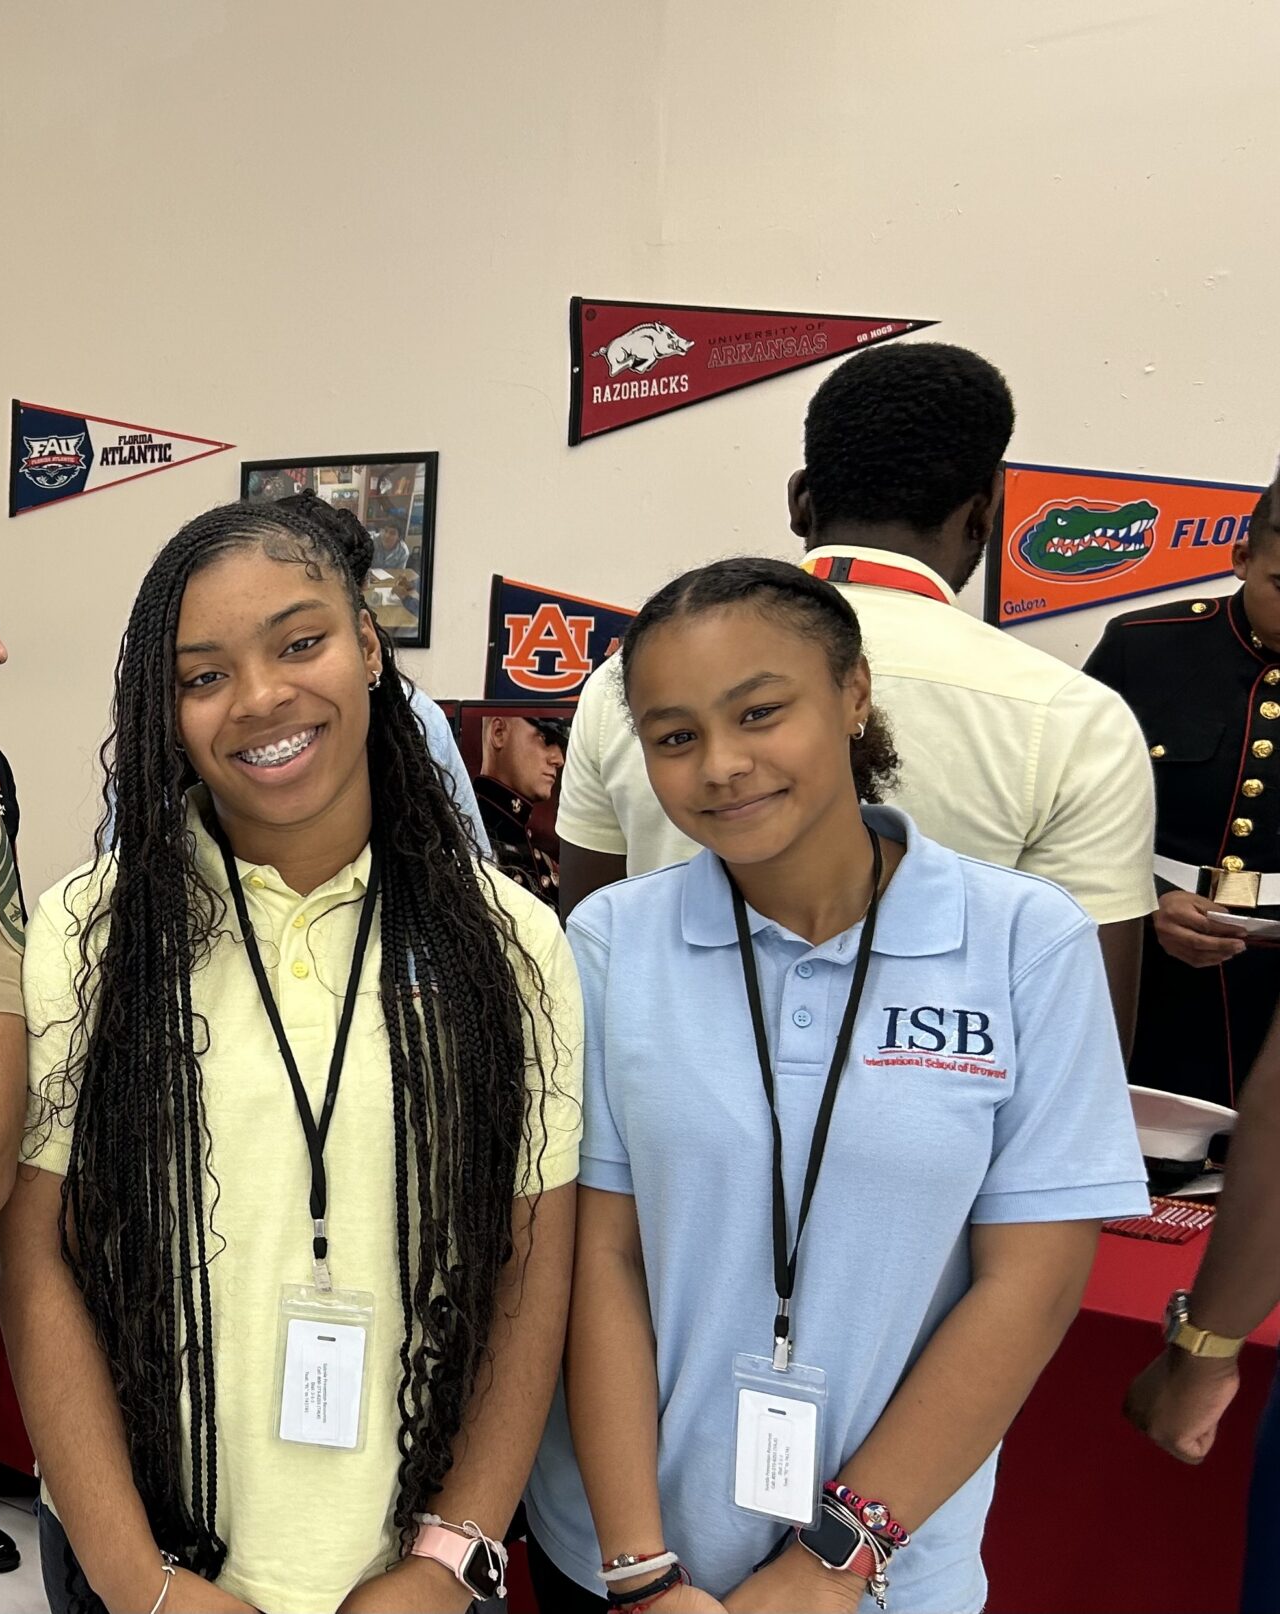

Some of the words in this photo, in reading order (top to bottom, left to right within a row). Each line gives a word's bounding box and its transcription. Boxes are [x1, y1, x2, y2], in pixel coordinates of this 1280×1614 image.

[708, 325, 799, 345] UNIVERSITY
[805, 322, 826, 332] OF
[856, 333, 868, 343] GO
[870, 324, 893, 339] HOGS
[707, 333, 828, 369] ARKANSAS
[592, 374, 689, 404] RAZORBACKS
[29, 438, 77, 457] FAU
[118, 433, 153, 446] FLORIDA
[100, 443, 172, 466] ATLANTIC
[1003, 598, 1047, 615] Gators
[877, 1006, 995, 1056] ISB
[863, 1055, 923, 1067] International
[925, 1058, 956, 1071] School
[958, 1063, 969, 1073] of
